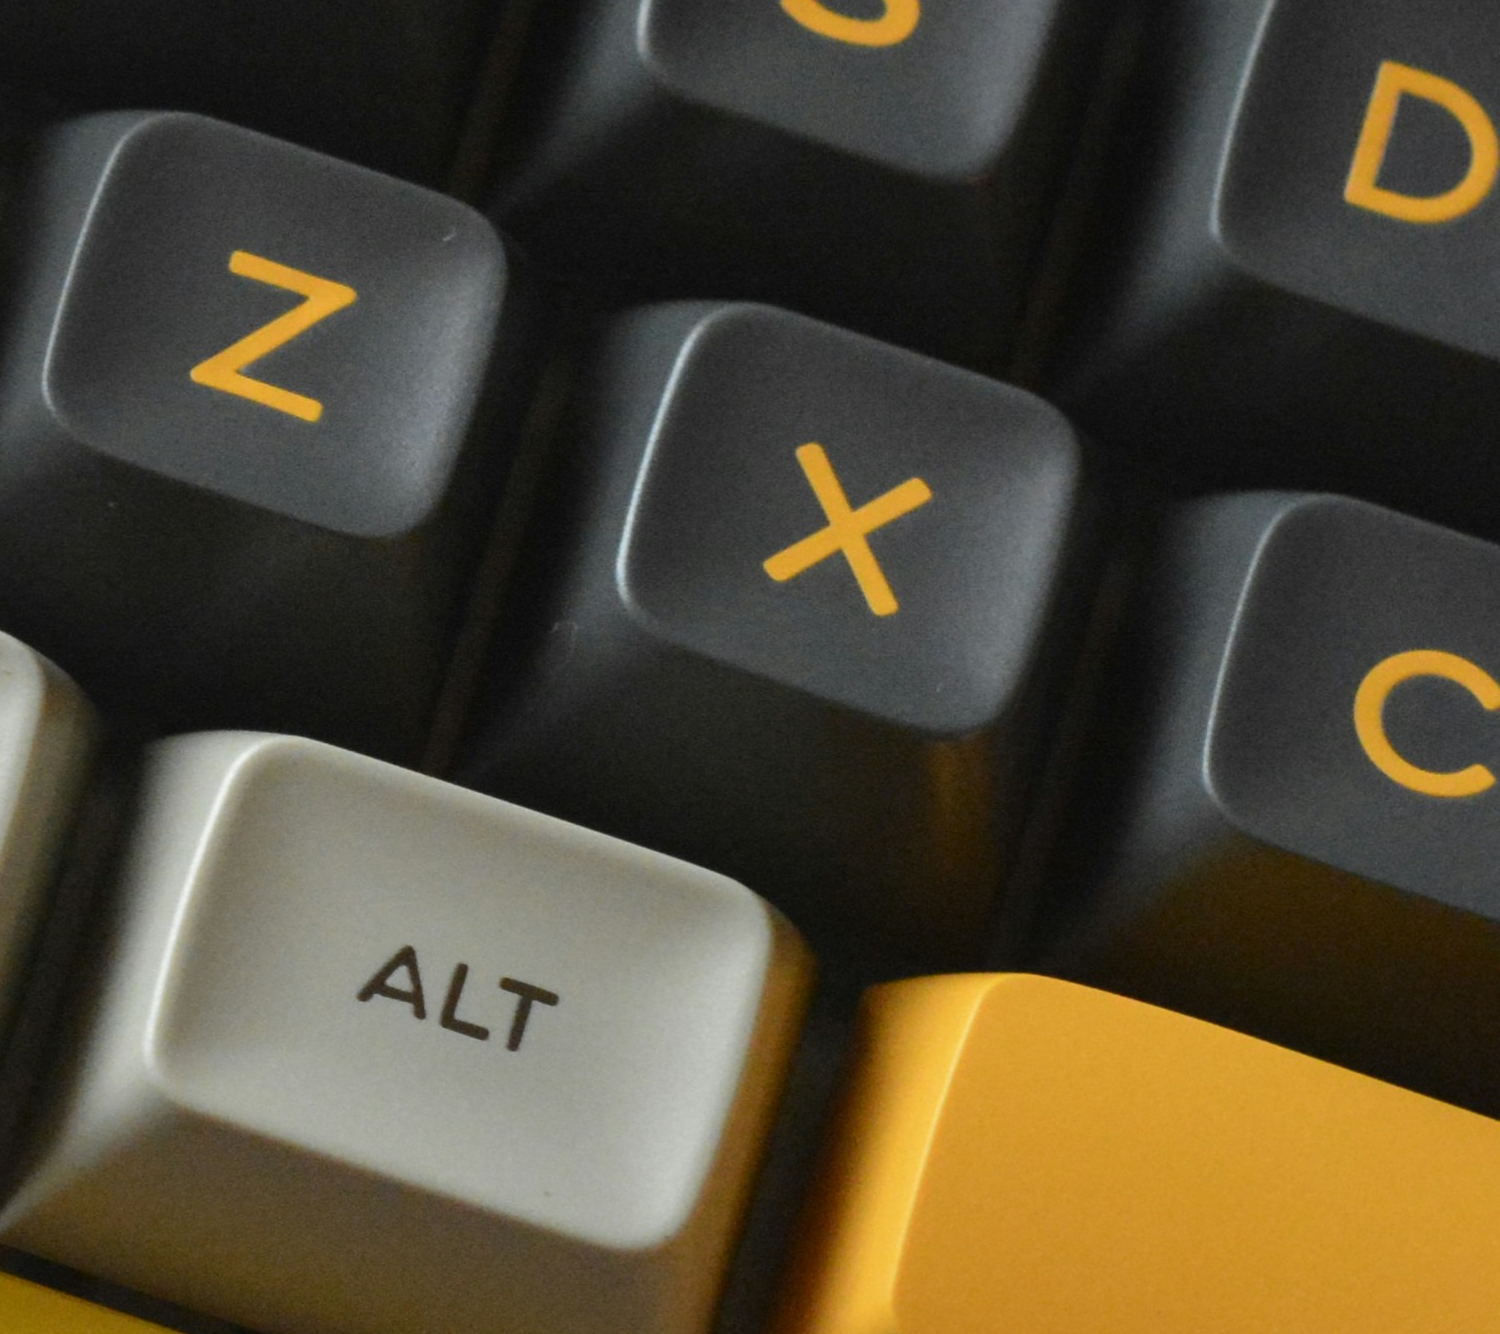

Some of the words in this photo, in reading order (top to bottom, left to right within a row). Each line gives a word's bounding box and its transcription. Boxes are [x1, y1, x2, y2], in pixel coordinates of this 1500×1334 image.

[1344, 60, 1500, 225] D
[190, 249, 358, 424] Z
[762, 441, 934, 618] X
[1352, 648, 1500, 799] C
[355, 943, 561, 1054] ALT
